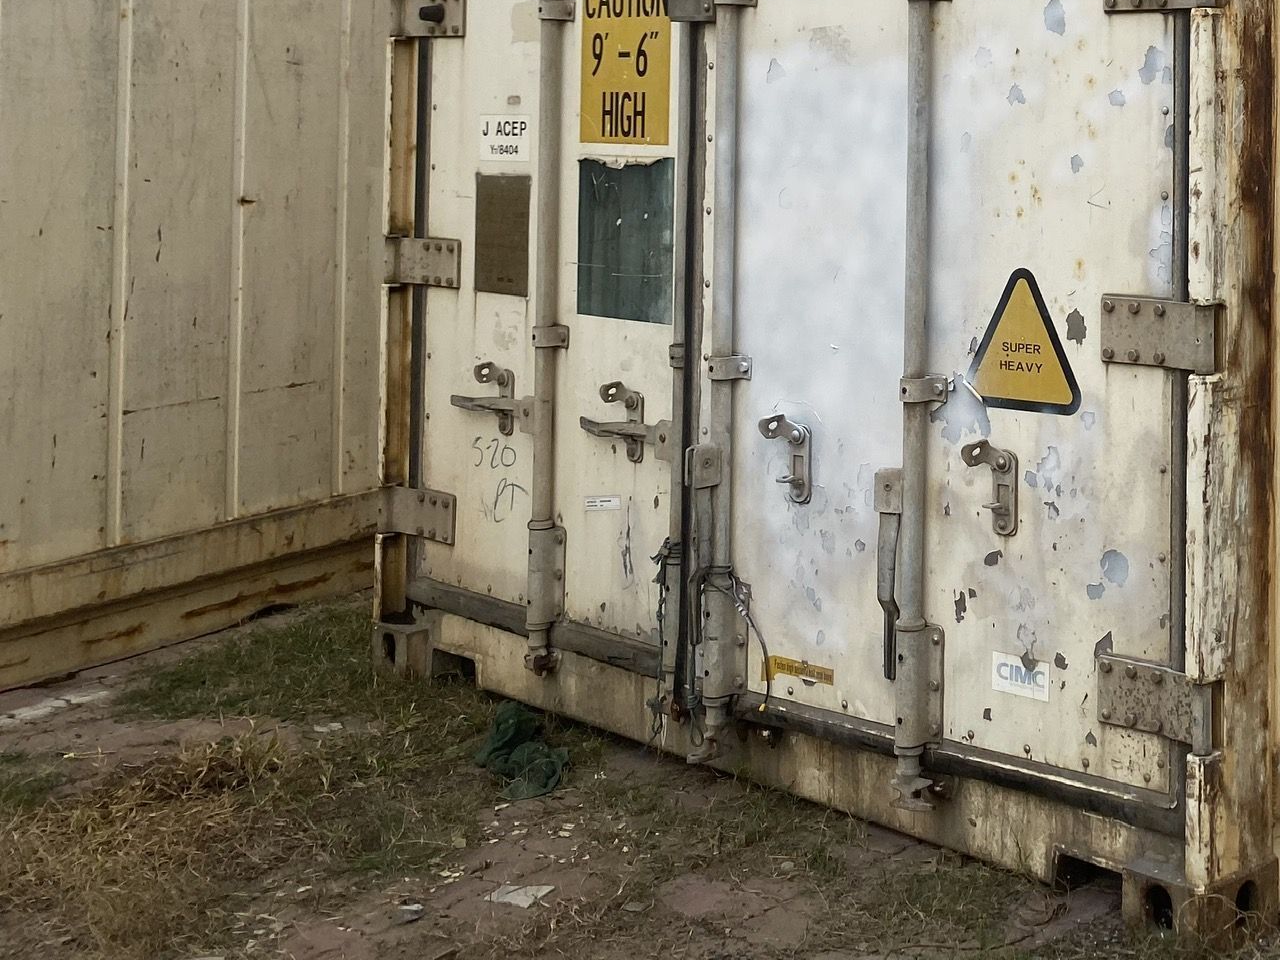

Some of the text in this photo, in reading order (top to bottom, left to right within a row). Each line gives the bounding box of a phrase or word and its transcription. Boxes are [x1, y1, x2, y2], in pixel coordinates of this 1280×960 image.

[601, 91, 646, 138] HIGH
[495, 120, 527, 137] ACEP
[1001, 341, 1042, 356] SUPER
[999, 360, 1043, 374] HEAVY
[996, 662, 1046, 690] CIMC
